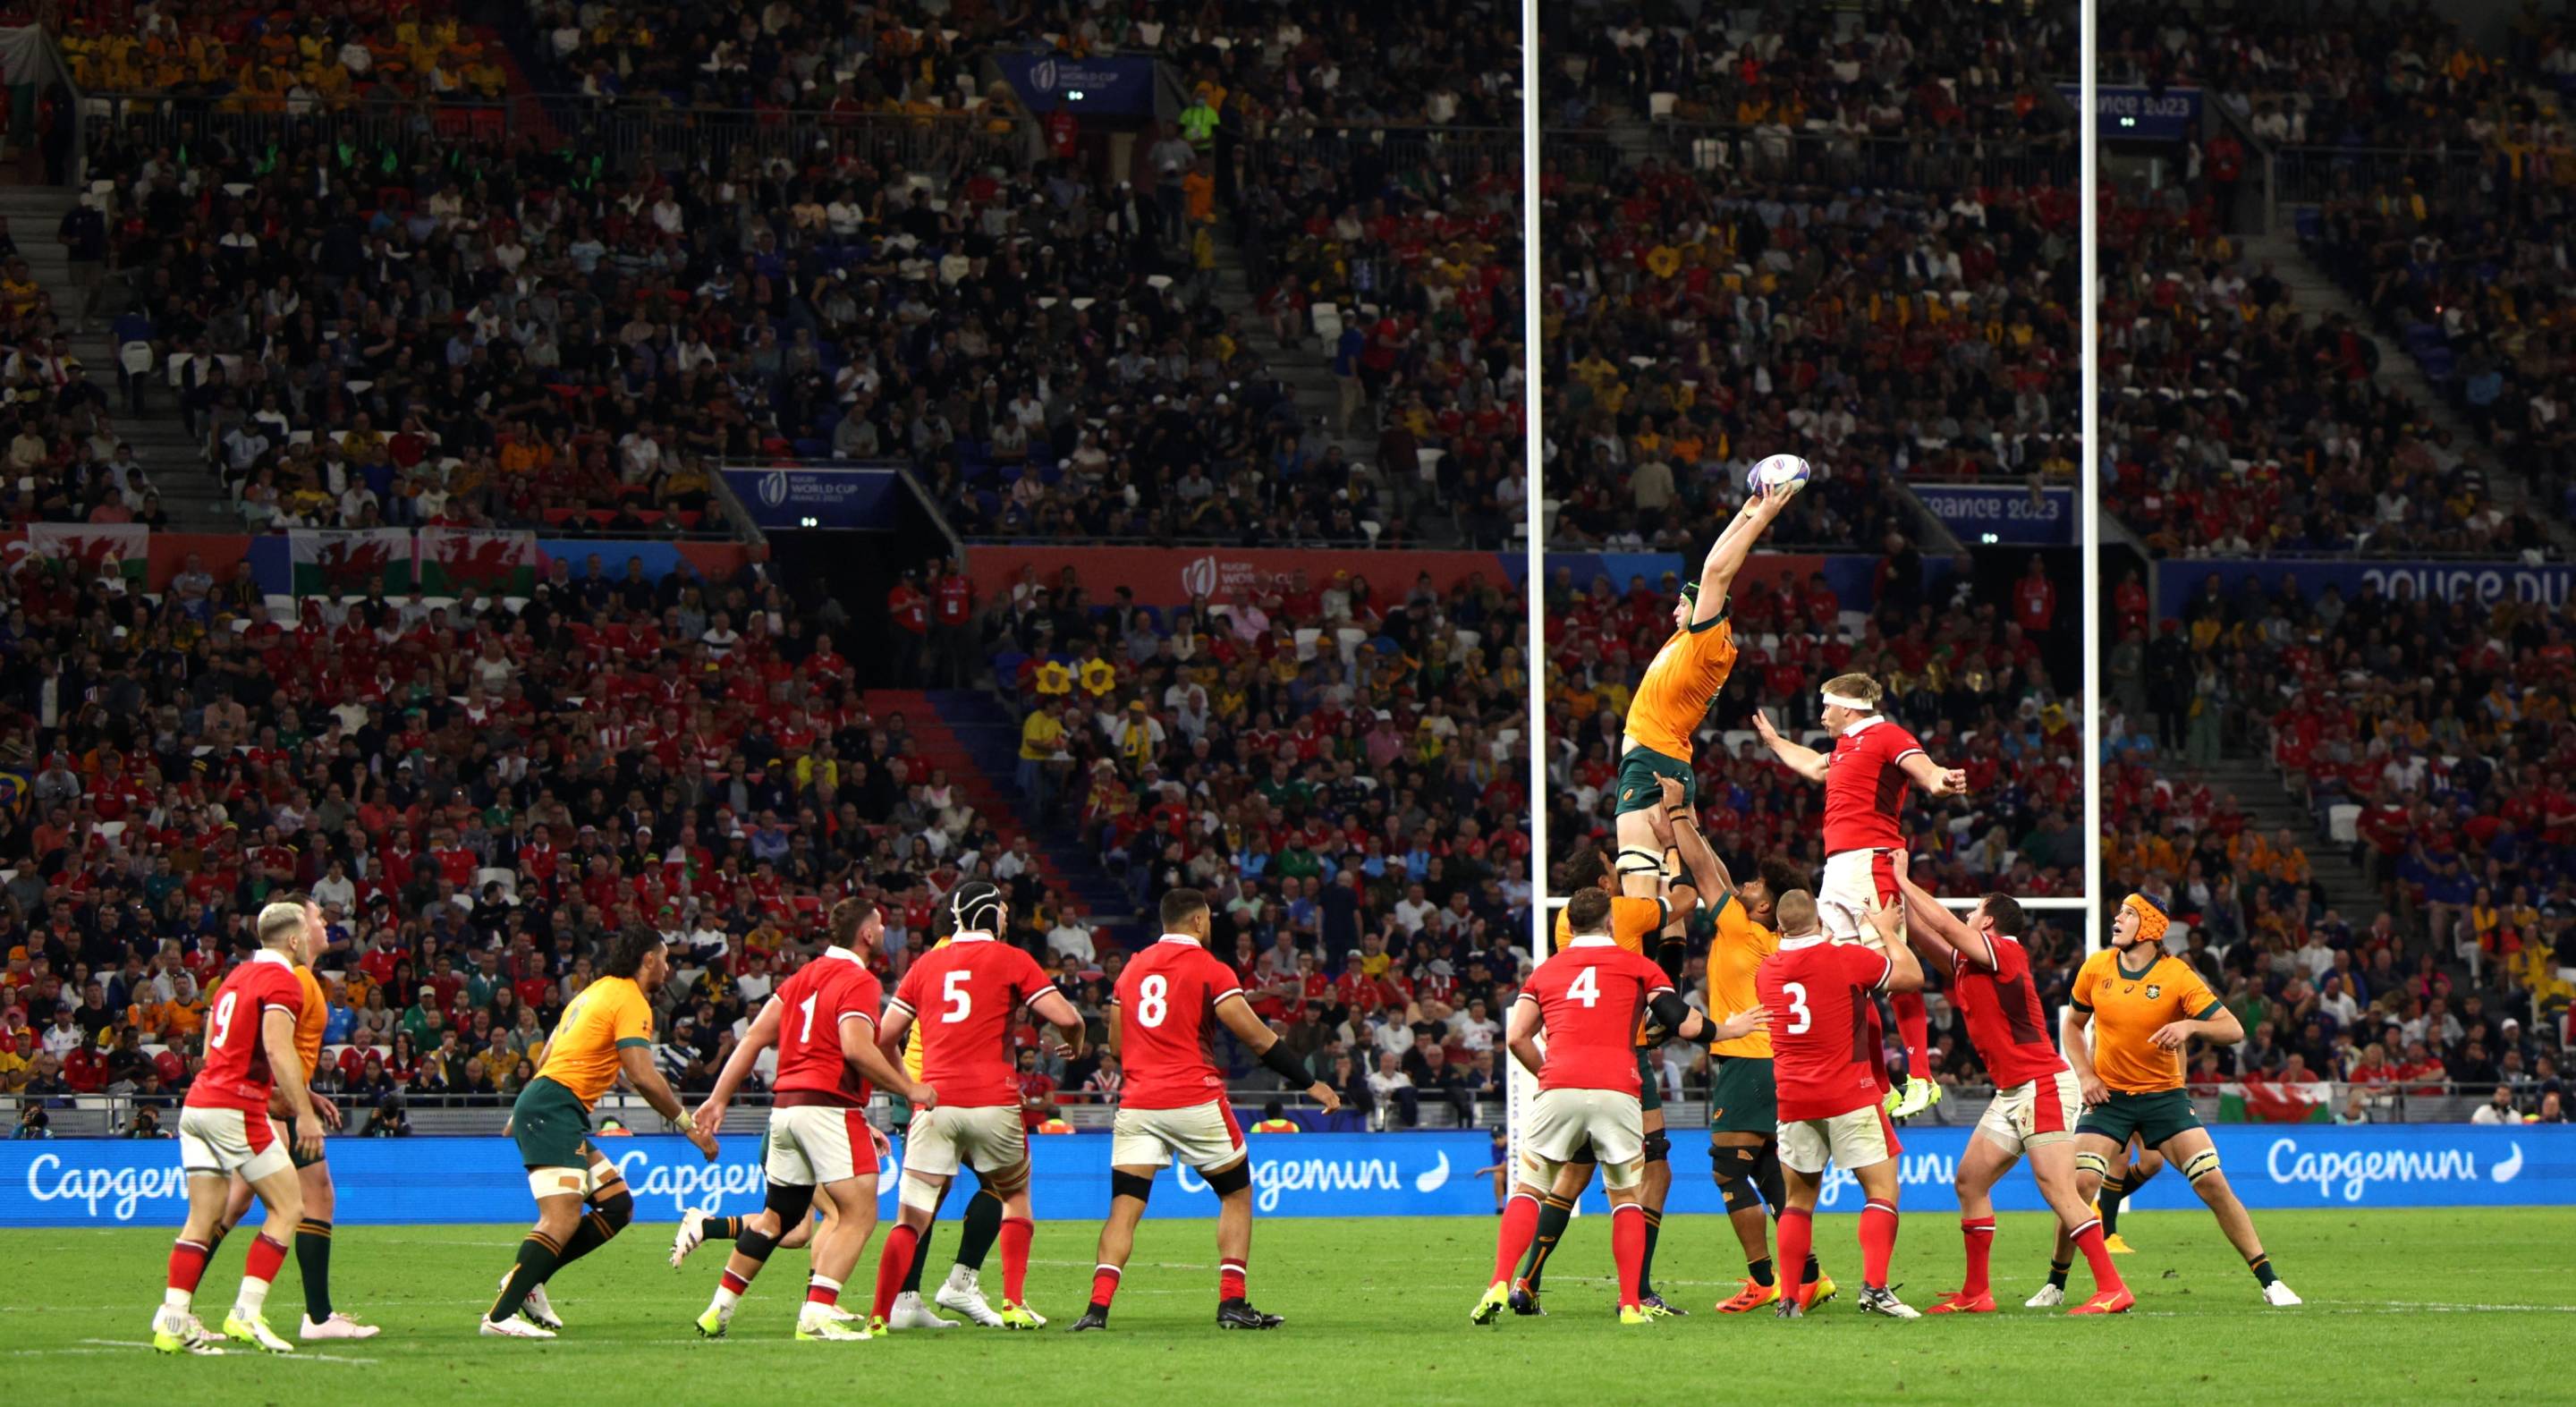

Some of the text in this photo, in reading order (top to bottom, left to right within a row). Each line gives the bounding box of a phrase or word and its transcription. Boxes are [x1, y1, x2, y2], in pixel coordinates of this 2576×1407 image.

[791, 484, 859, 495] WORLD CUP
[941, 970, 971, 1023] 5
[1138, 973, 1167, 1028] 8
[1567, 966, 1600, 1008] 4
[1783, 981, 1811, 1034] 3
[211, 991, 237, 1048] 9
[799, 989, 818, 1044] 1
[28, 1153, 190, 1220] Capgem
[617, 1150, 768, 1214] Capge
[1176, 1152, 1402, 1212] Cgemini
[2267, 1138, 2478, 1201] Capgemini
